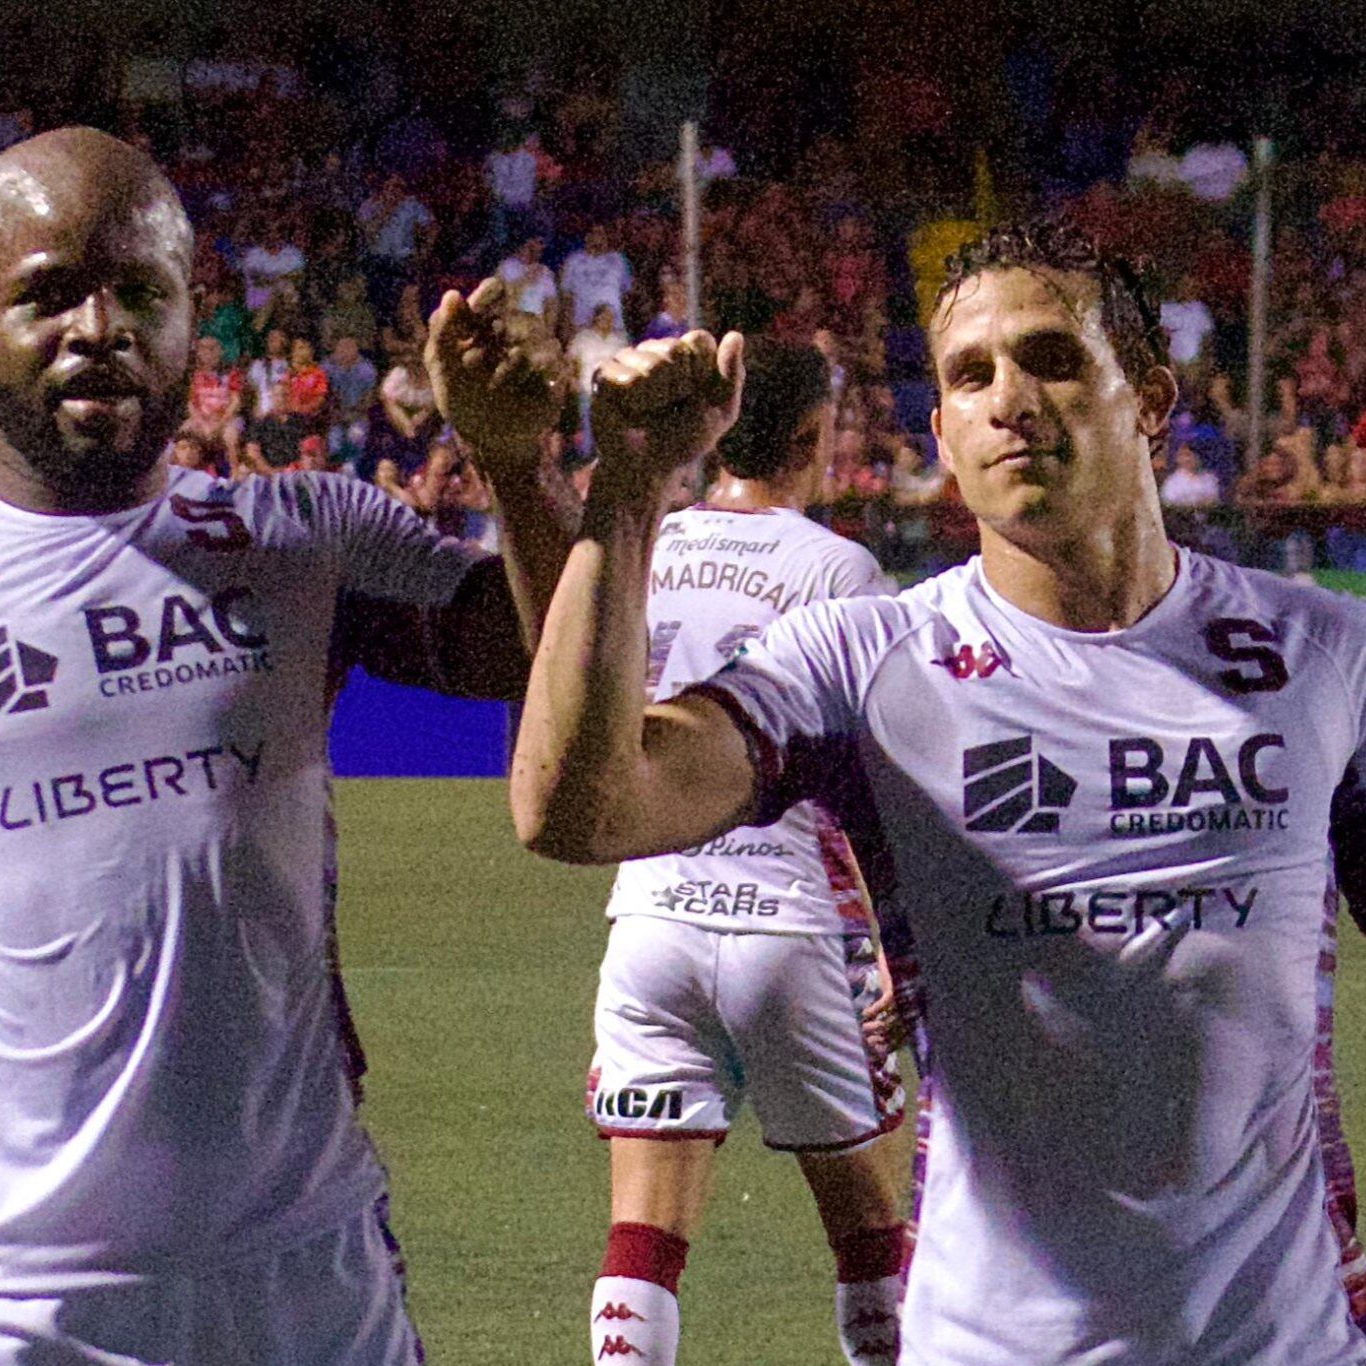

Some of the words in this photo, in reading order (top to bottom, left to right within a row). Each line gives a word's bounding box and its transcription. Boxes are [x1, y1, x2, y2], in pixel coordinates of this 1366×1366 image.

[667, 532, 781, 556] medismart
[84, 586, 269, 674] BAC
[100, 651, 273, 698] CREDOMATIC
[1204, 617, 1288, 695] S
[0, 741, 265, 830] LIBERTY
[1108, 733, 1290, 810] BAC
[1110, 809, 1289, 835] CREDOMATIC
[675, 881, 759, 900] STAR
[684, 898, 779, 916] CARS
[987, 887, 1259, 937] LIBERTY
